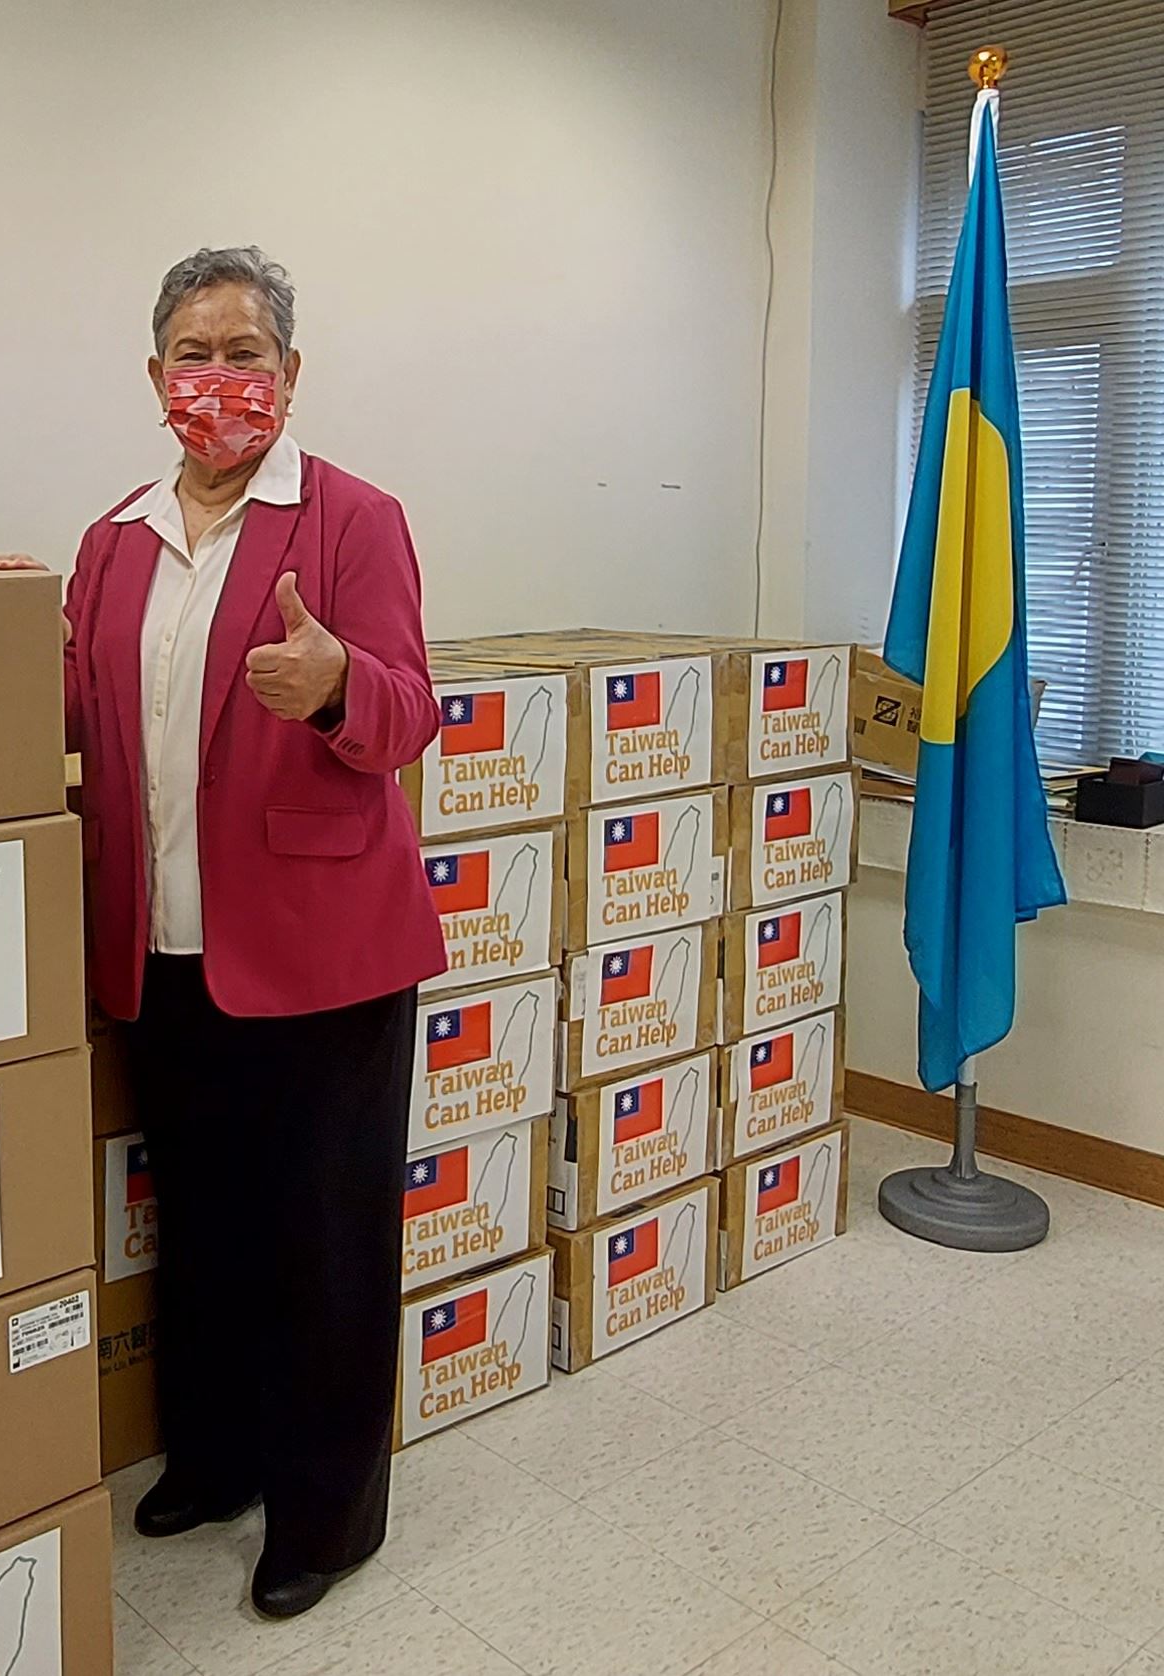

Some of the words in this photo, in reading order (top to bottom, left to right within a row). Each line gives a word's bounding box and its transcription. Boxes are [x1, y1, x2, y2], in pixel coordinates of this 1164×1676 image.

[760, 713, 820, 732] Taiwan
[606, 730, 680, 755] Taiwan
[760, 740, 791, 760] Can
[796, 734, 828, 753] Help
[439, 755, 526, 784] Taiwan
[607, 759, 645, 784] Can
[649, 754, 691, 776] Help
[438, 787, 485, 816] Can
[488, 778, 540, 810] Help
[762, 839, 826, 864] Taiwan
[603, 869, 677, 897] Taiwan
[763, 869, 795, 890] Can
[800, 863, 831, 880] Help
[602, 901, 642, 927] Can
[647, 886, 691, 916] Help
[441, 912, 510, 940] aiwan
[471, 934, 523, 967] Help
[755, 964, 814, 989] Taiwan
[599, 1000, 667, 1028] Taiwan
[755, 992, 786, 1015] Can
[792, 982, 822, 1002] Help
[596, 1032, 634, 1057] Can
[638, 1021, 678, 1045] Help
[426, 1060, 514, 1097] Taiwan
[425, 1104, 471, 1133] Can
[476, 1082, 528, 1118] Help
[750, 1081, 808, 1112] Taiwan
[746, 1118, 777, 1139] Can
[782, 1100, 813, 1125] Help
[612, 1134, 678, 1165] Taiwan
[611, 1171, 646, 1195] Can
[650, 1154, 687, 1179] Help
[754, 1204, 810, 1234] Taiwan
[400, 1246, 447, 1278] Can
[452, 1226, 504, 1260] Help
[753, 1240, 782, 1260] Can
[787, 1222, 818, 1244] Help
[607, 1270, 675, 1309] Taiwan
[607, 1309, 640, 1337] Can
[648, 1287, 686, 1317] Help
[420, 1342, 507, 1393] Taiwan
[420, 1390, 466, 1422] Can
[471, 1360, 522, 1399] Help
